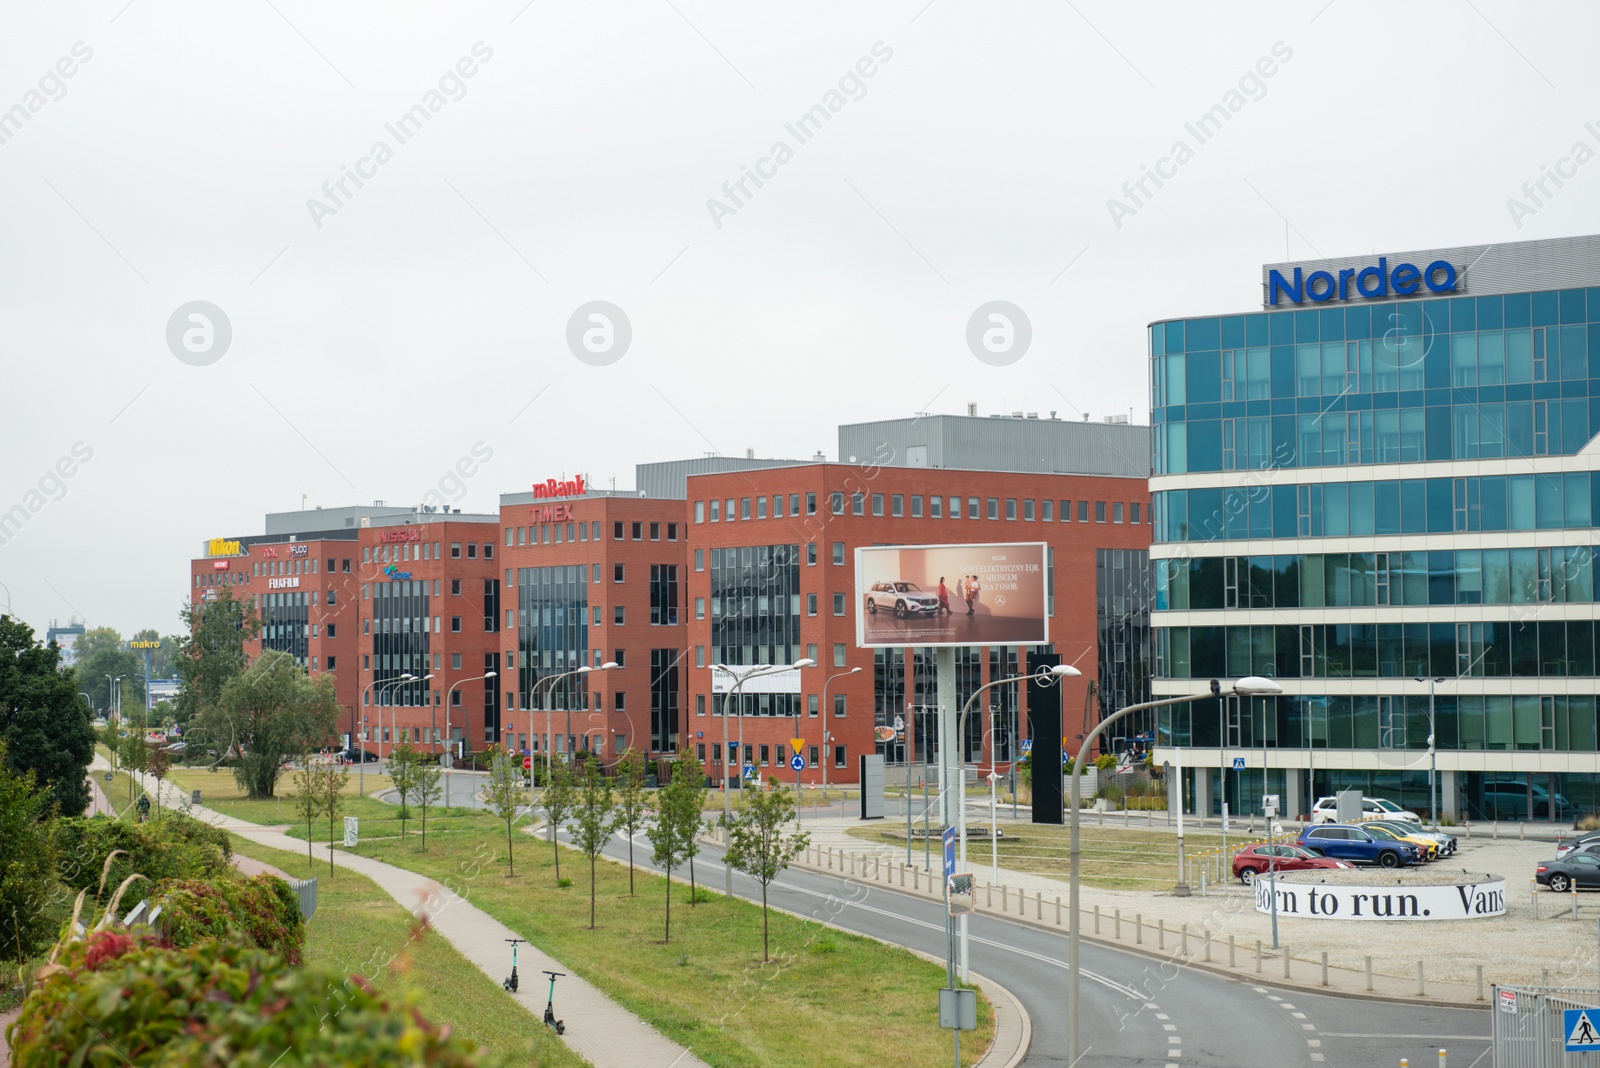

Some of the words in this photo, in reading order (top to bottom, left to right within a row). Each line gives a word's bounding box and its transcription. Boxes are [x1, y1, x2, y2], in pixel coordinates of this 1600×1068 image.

[1269, 256, 1457, 306] Nordea
[532, 474, 586, 499] mBank
[529, 504, 573, 524] TIMEX
[380, 529, 420, 543] NISSAN
[208, 538, 240, 557] Nikon
[980, 564, 1024, 573] ELEKTRYCZNY
[986, 574, 1018, 582] MIEJSCEM
[130, 640, 160, 649] makro
[1308, 887, 1338, 915] to
[1351, 894, 1430, 916] run.
